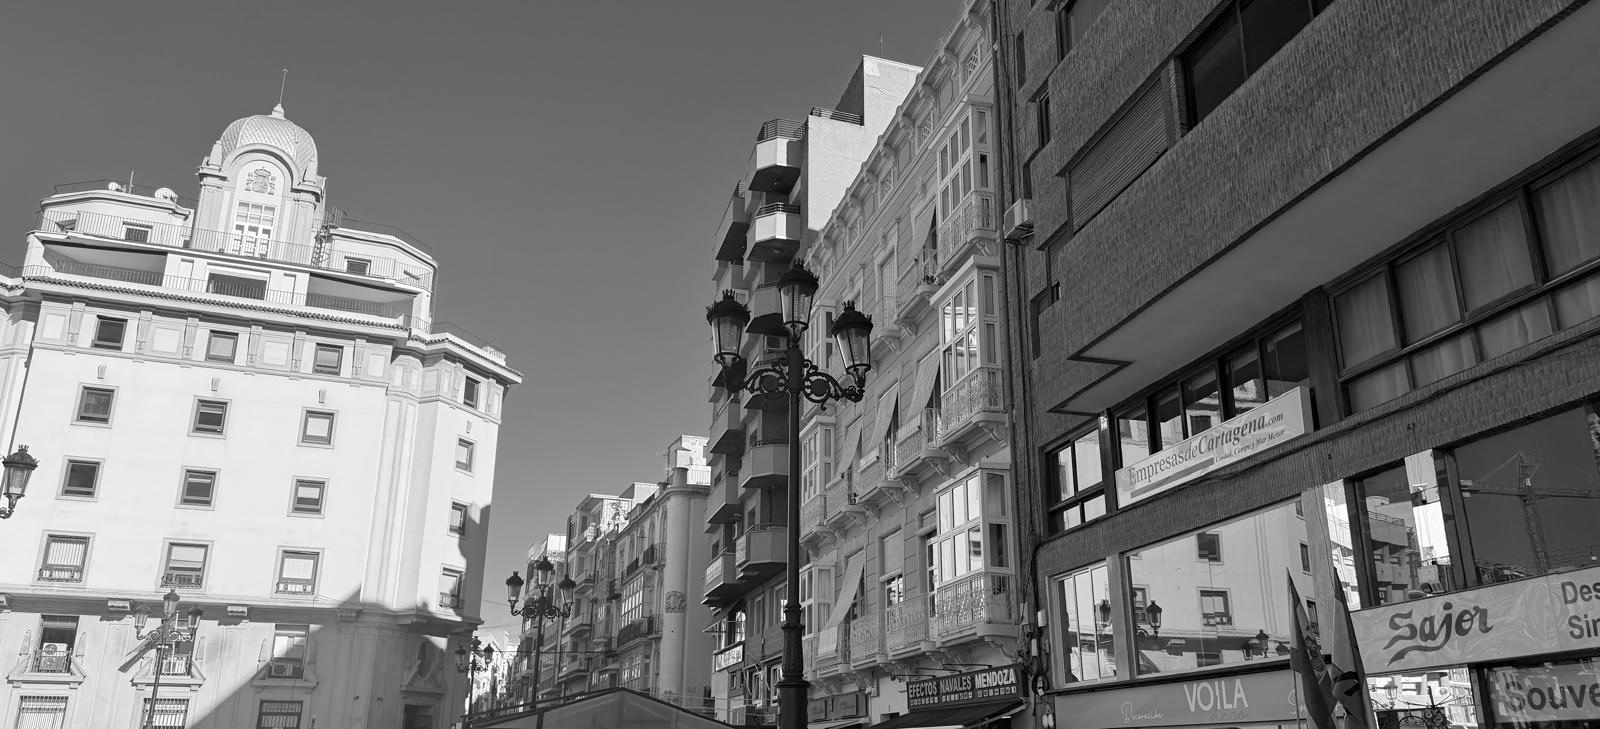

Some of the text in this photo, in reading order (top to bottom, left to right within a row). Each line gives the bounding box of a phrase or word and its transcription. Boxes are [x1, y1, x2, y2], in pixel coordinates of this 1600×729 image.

[1128, 411, 1284, 486] EmpresasdeCartagena.com
[1382, 601, 1494, 667] Sajor
[908, 668, 1017, 698] EFECTOS NAVALES MENDOZA
[1183, 678, 1249, 713] VOILA
